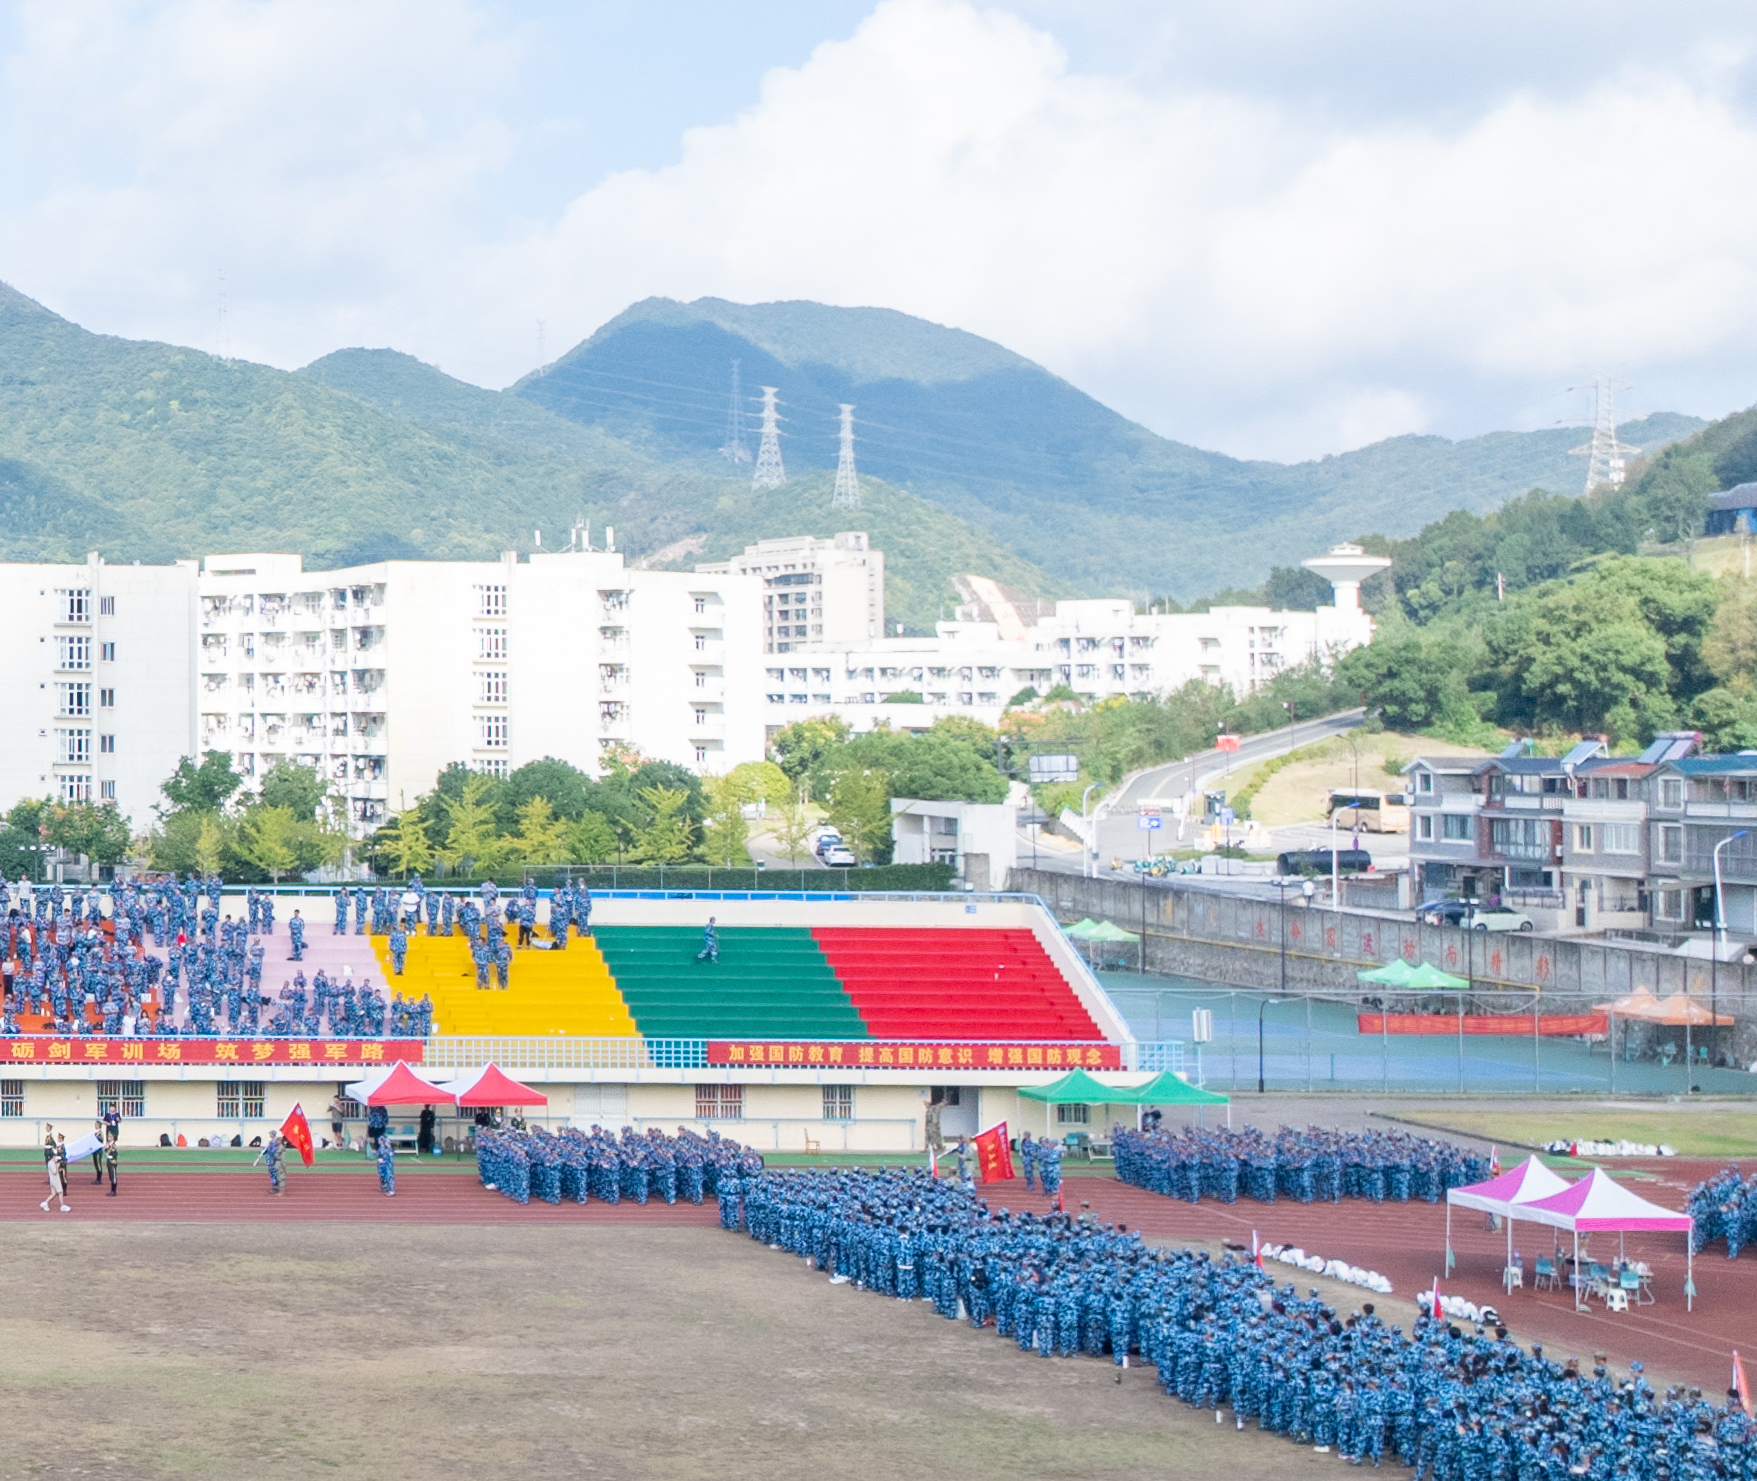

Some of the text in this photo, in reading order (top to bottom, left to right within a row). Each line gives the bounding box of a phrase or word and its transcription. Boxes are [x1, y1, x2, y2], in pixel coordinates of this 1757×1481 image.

[10, 1041, 385, 1061] 砺剑军训场 筑梦强军路
[728, 1044, 1103, 1066] 加强国防教育 提高国防意识 增强国防观念
